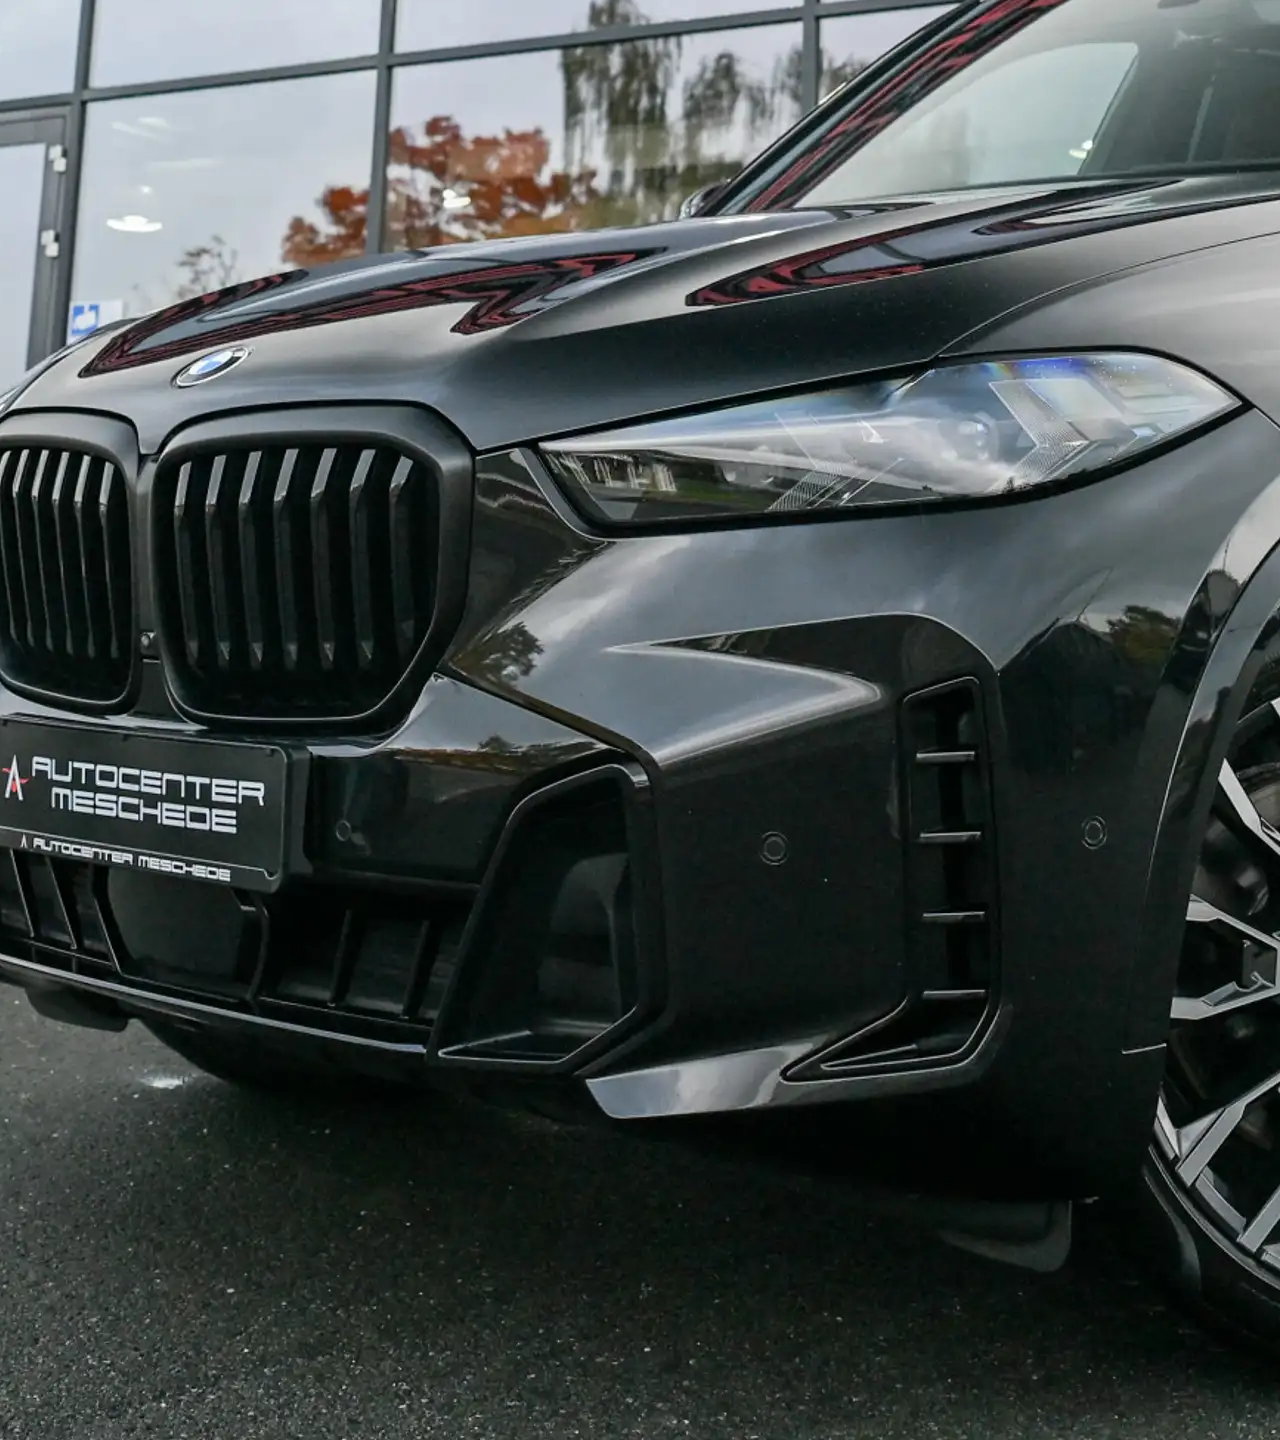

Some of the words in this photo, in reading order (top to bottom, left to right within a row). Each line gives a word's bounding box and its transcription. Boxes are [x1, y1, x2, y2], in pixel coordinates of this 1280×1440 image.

[32, 755, 265, 807] AUTOCENTER
[51, 786, 237, 835] MESCHEDE
[32, 837, 133, 867] AUTOCENTER
[137, 854, 231, 882] MESCHEDE
